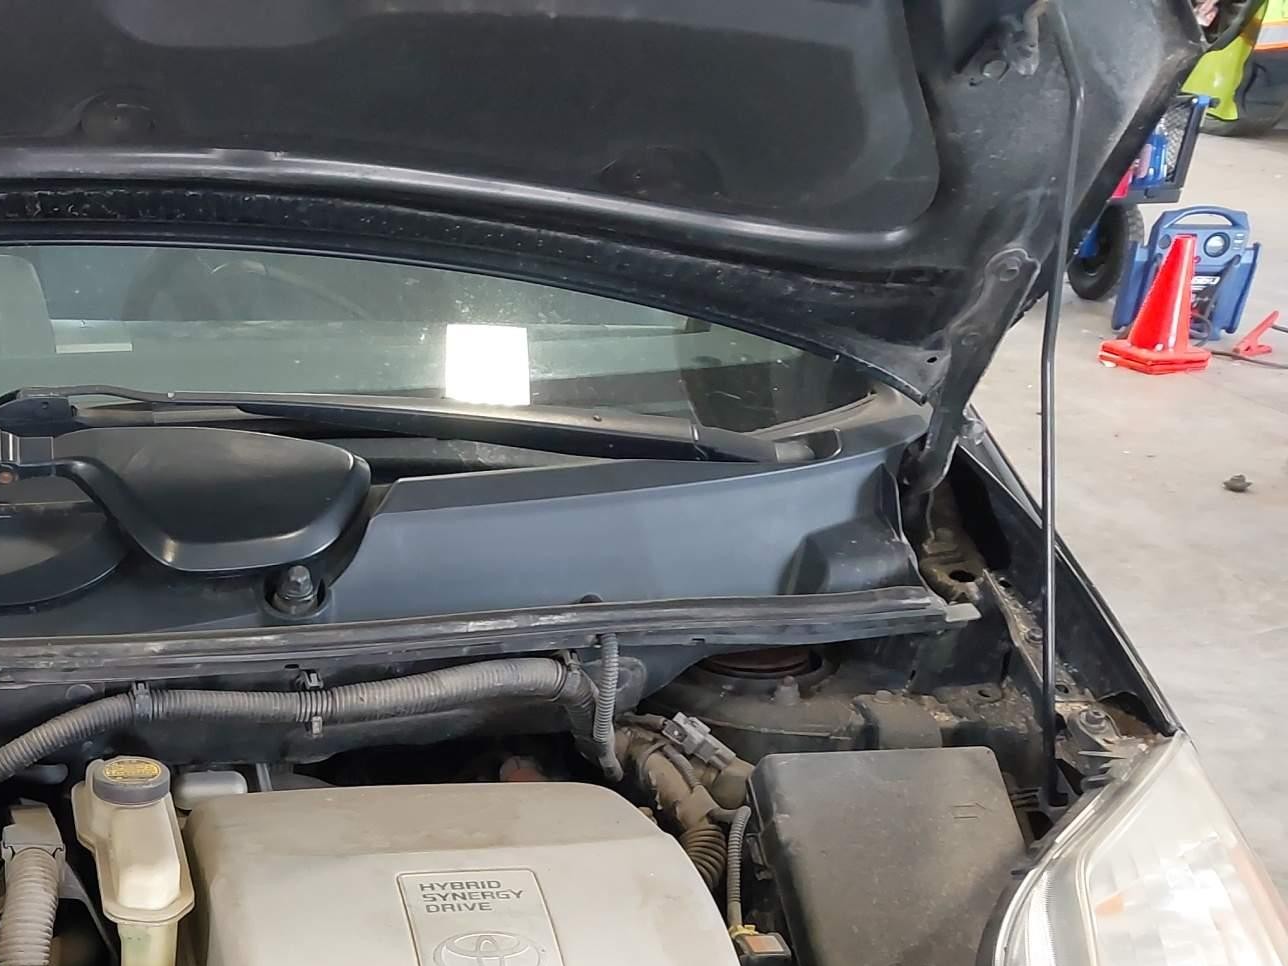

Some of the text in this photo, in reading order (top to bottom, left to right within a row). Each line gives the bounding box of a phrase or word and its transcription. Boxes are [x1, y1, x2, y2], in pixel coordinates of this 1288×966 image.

[419, 880, 502, 892] HYBRID
[422, 889, 524, 902] SYNERGY
[425, 901, 493, 913] DRIVE
